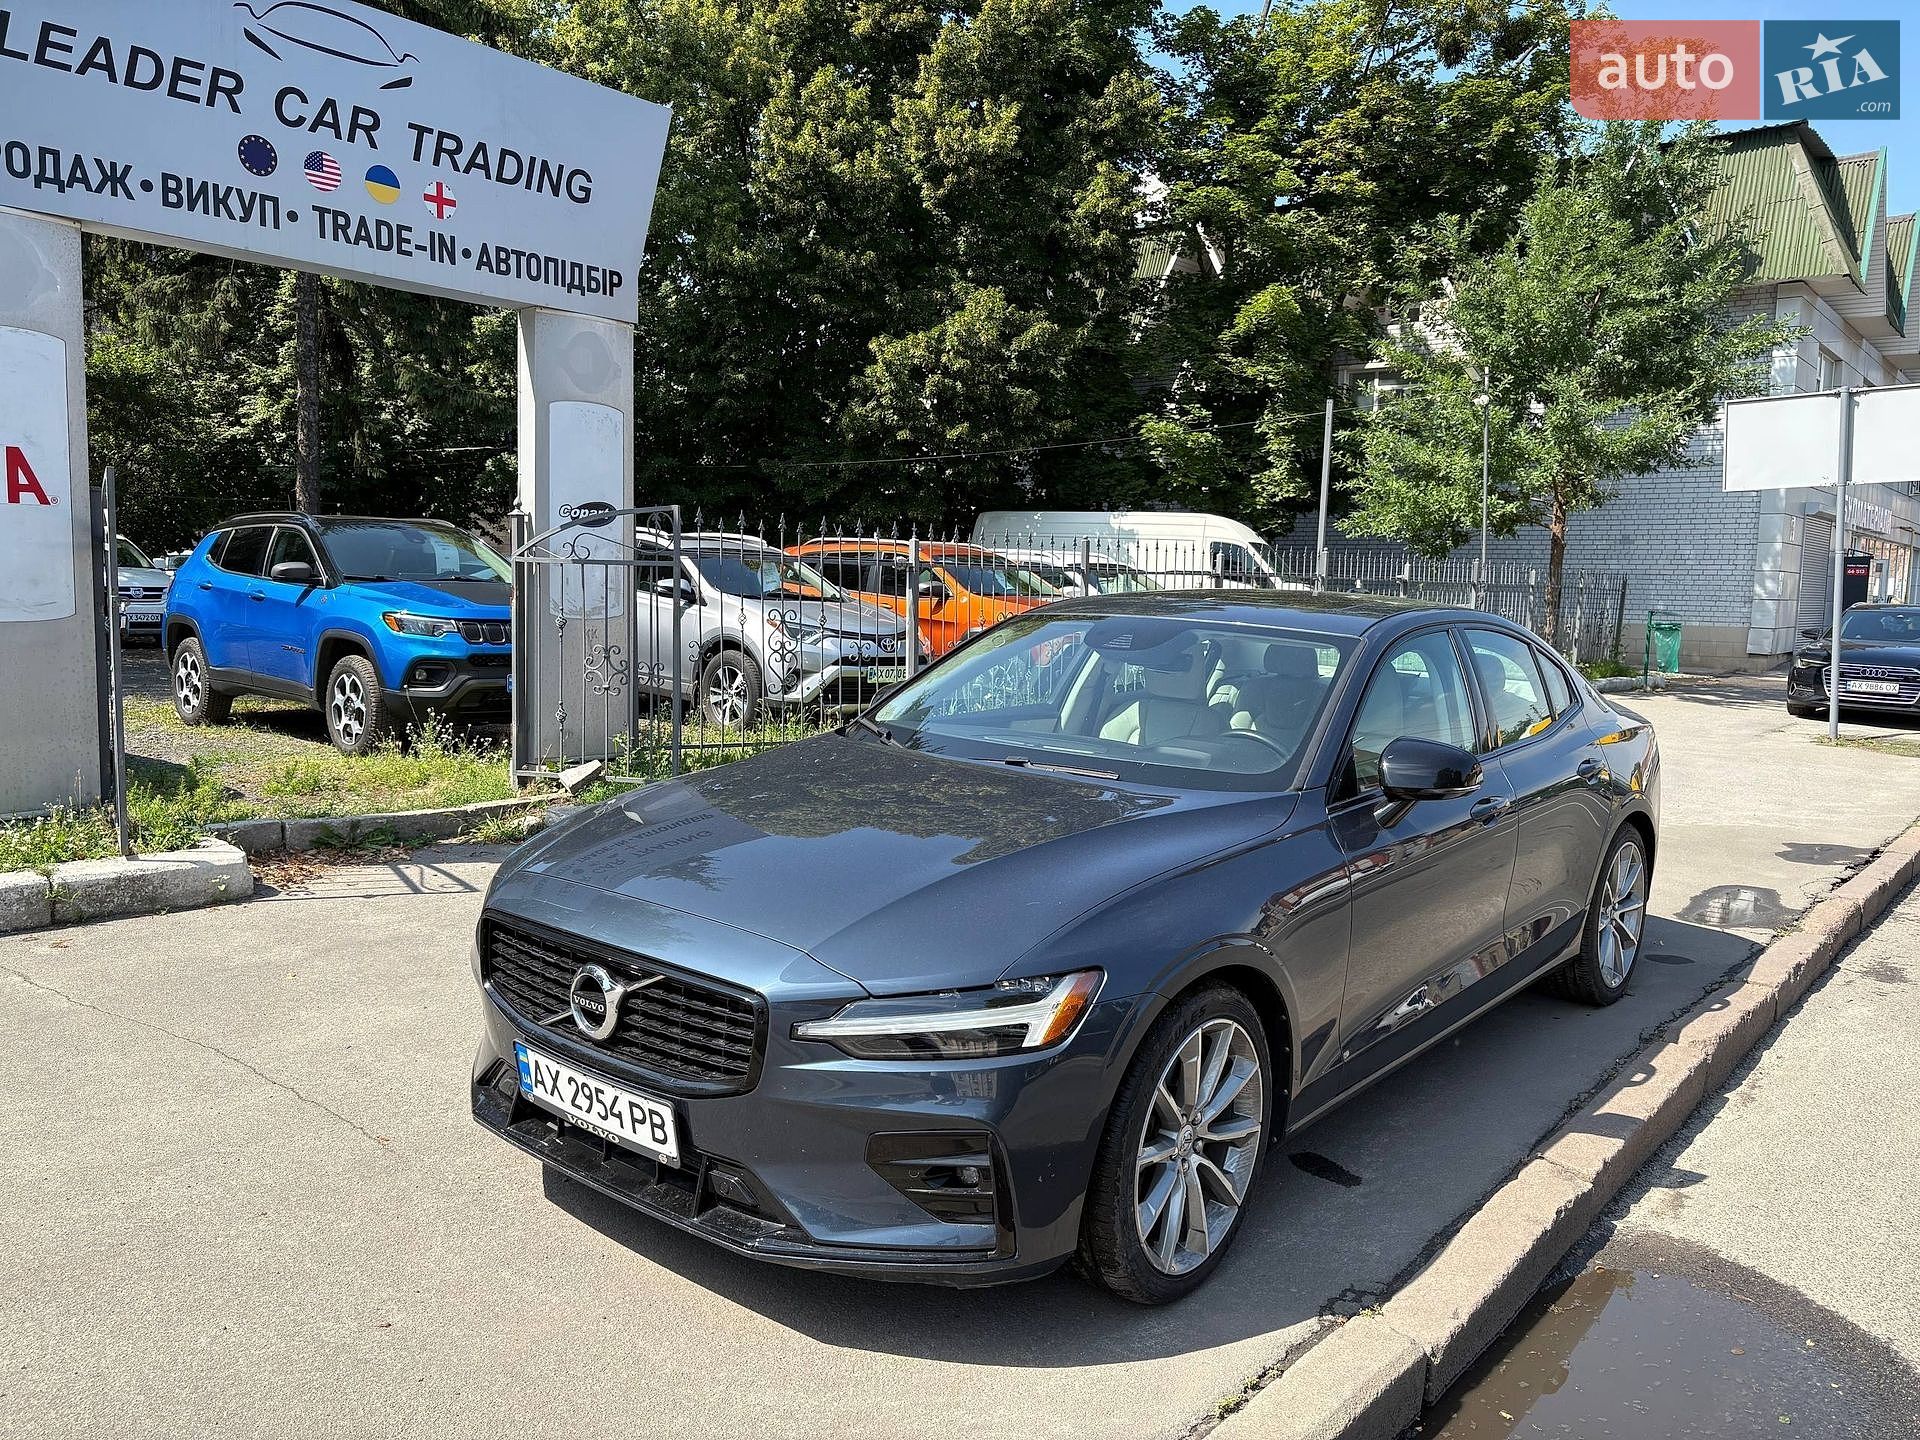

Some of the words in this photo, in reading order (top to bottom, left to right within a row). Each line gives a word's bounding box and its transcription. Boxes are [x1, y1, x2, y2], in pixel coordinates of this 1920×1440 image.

[0, 9, 244, 114] LEADER
[274, 86, 381, 150] CAR
[407, 122, 592, 204] TRADING
[0, 140, 136, 201] ОДАЖ
[161, 172, 281, 230] ВИКУП
[312, 204, 456, 266] TRADE-IN
[475, 242, 623, 298] АВТОПІДБІР
[573, 994, 605, 1012] VOLVO
[522, 1072, 532, 1085] UA
[534, 1059, 565, 1103] AX
[567, 1076, 624, 1130] 2954
[628, 1100, 668, 1145] PB
[565, 1112, 620, 1144] VOLVO
